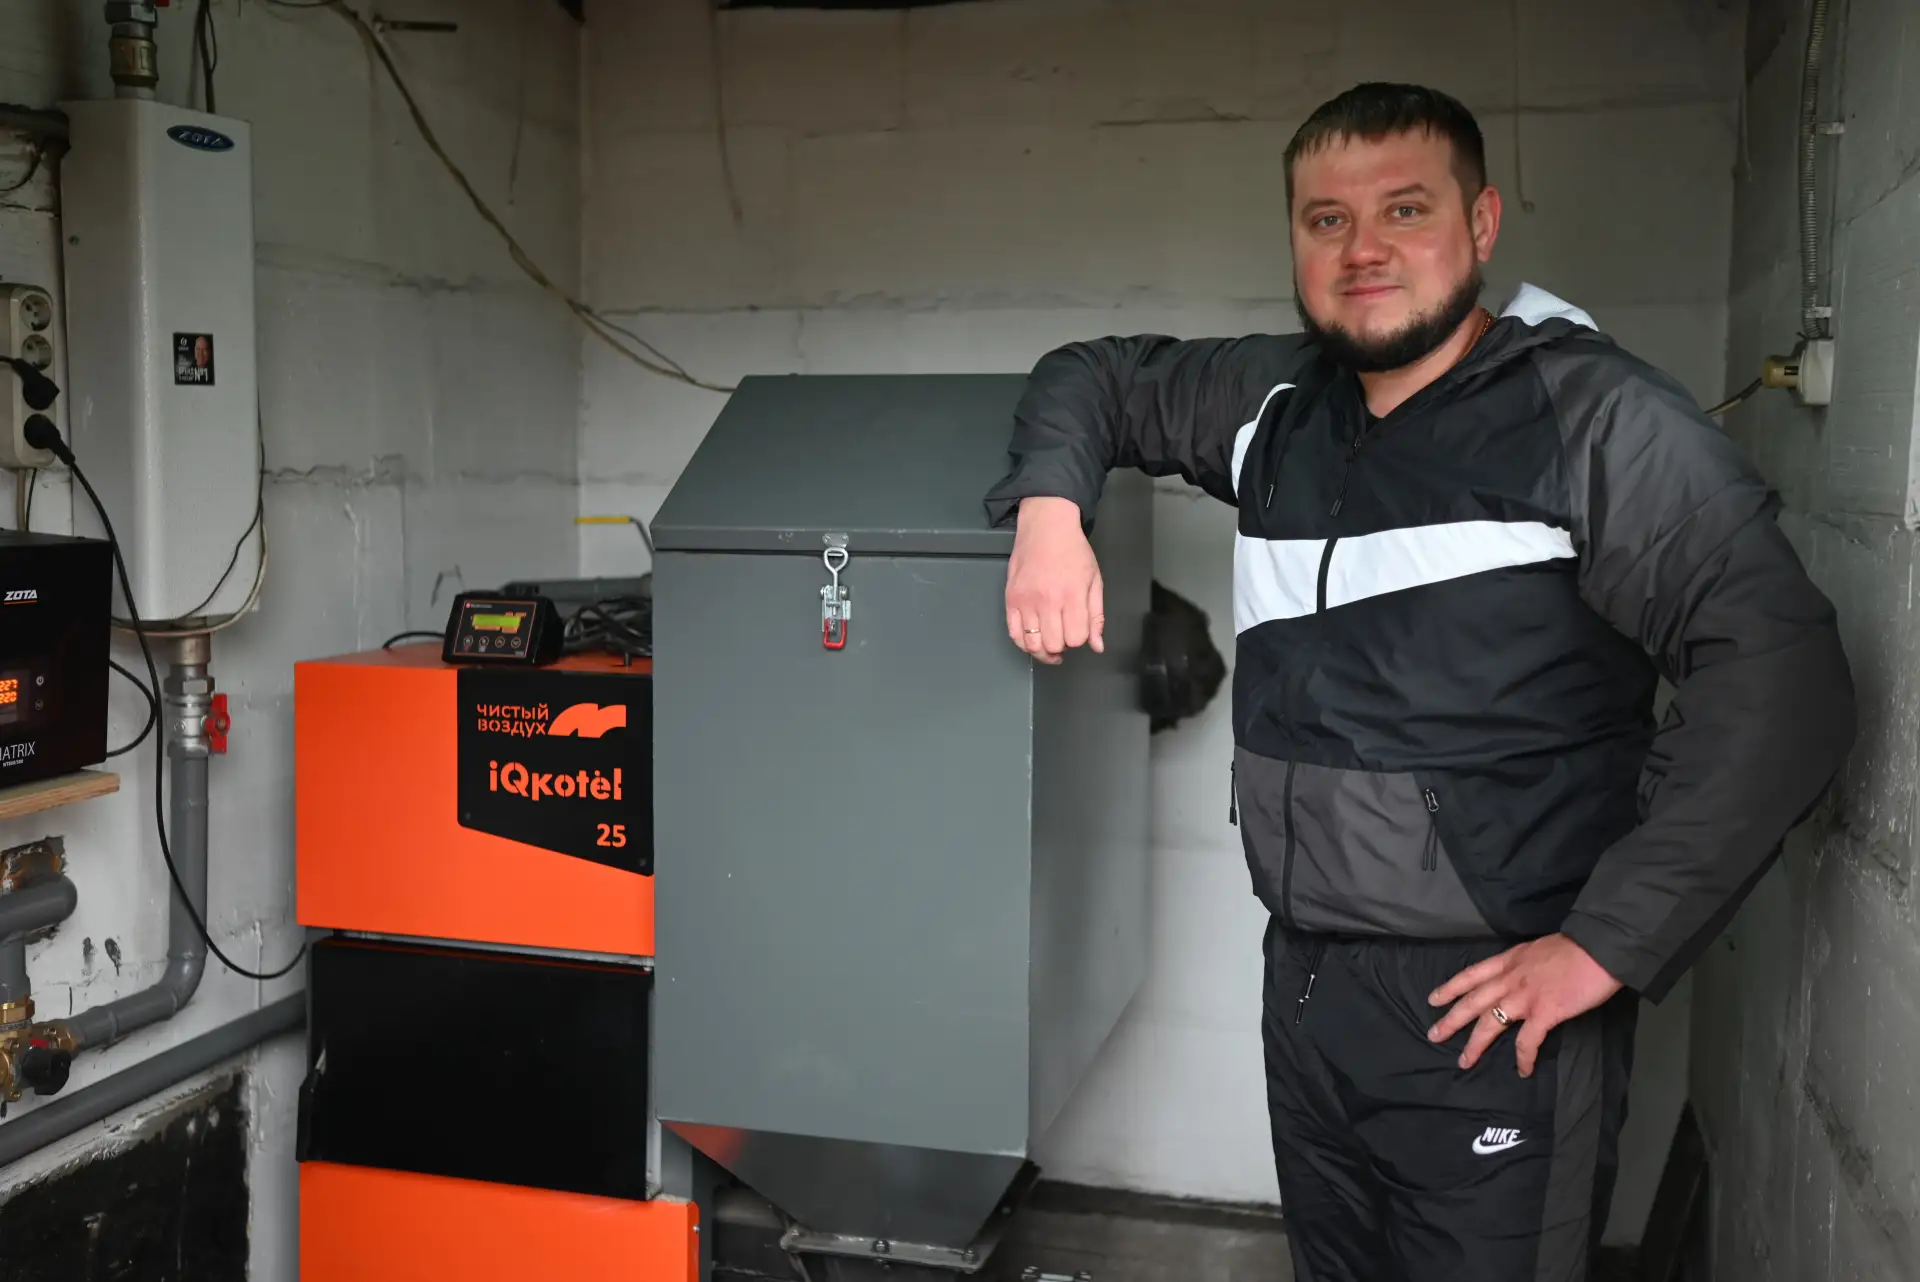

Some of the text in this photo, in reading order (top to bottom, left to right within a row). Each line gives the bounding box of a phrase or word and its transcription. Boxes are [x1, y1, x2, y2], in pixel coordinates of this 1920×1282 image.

[4, 590, 38, 601] ZOTA
[476, 703, 549, 721] ЧИСТЫЙ
[478, 718, 546, 738] ВОЗДУХ
[0, 741, 36, 761] ATRIX
[596, 823, 627, 848] 25
[1481, 1126, 1521, 1145] NIKE
